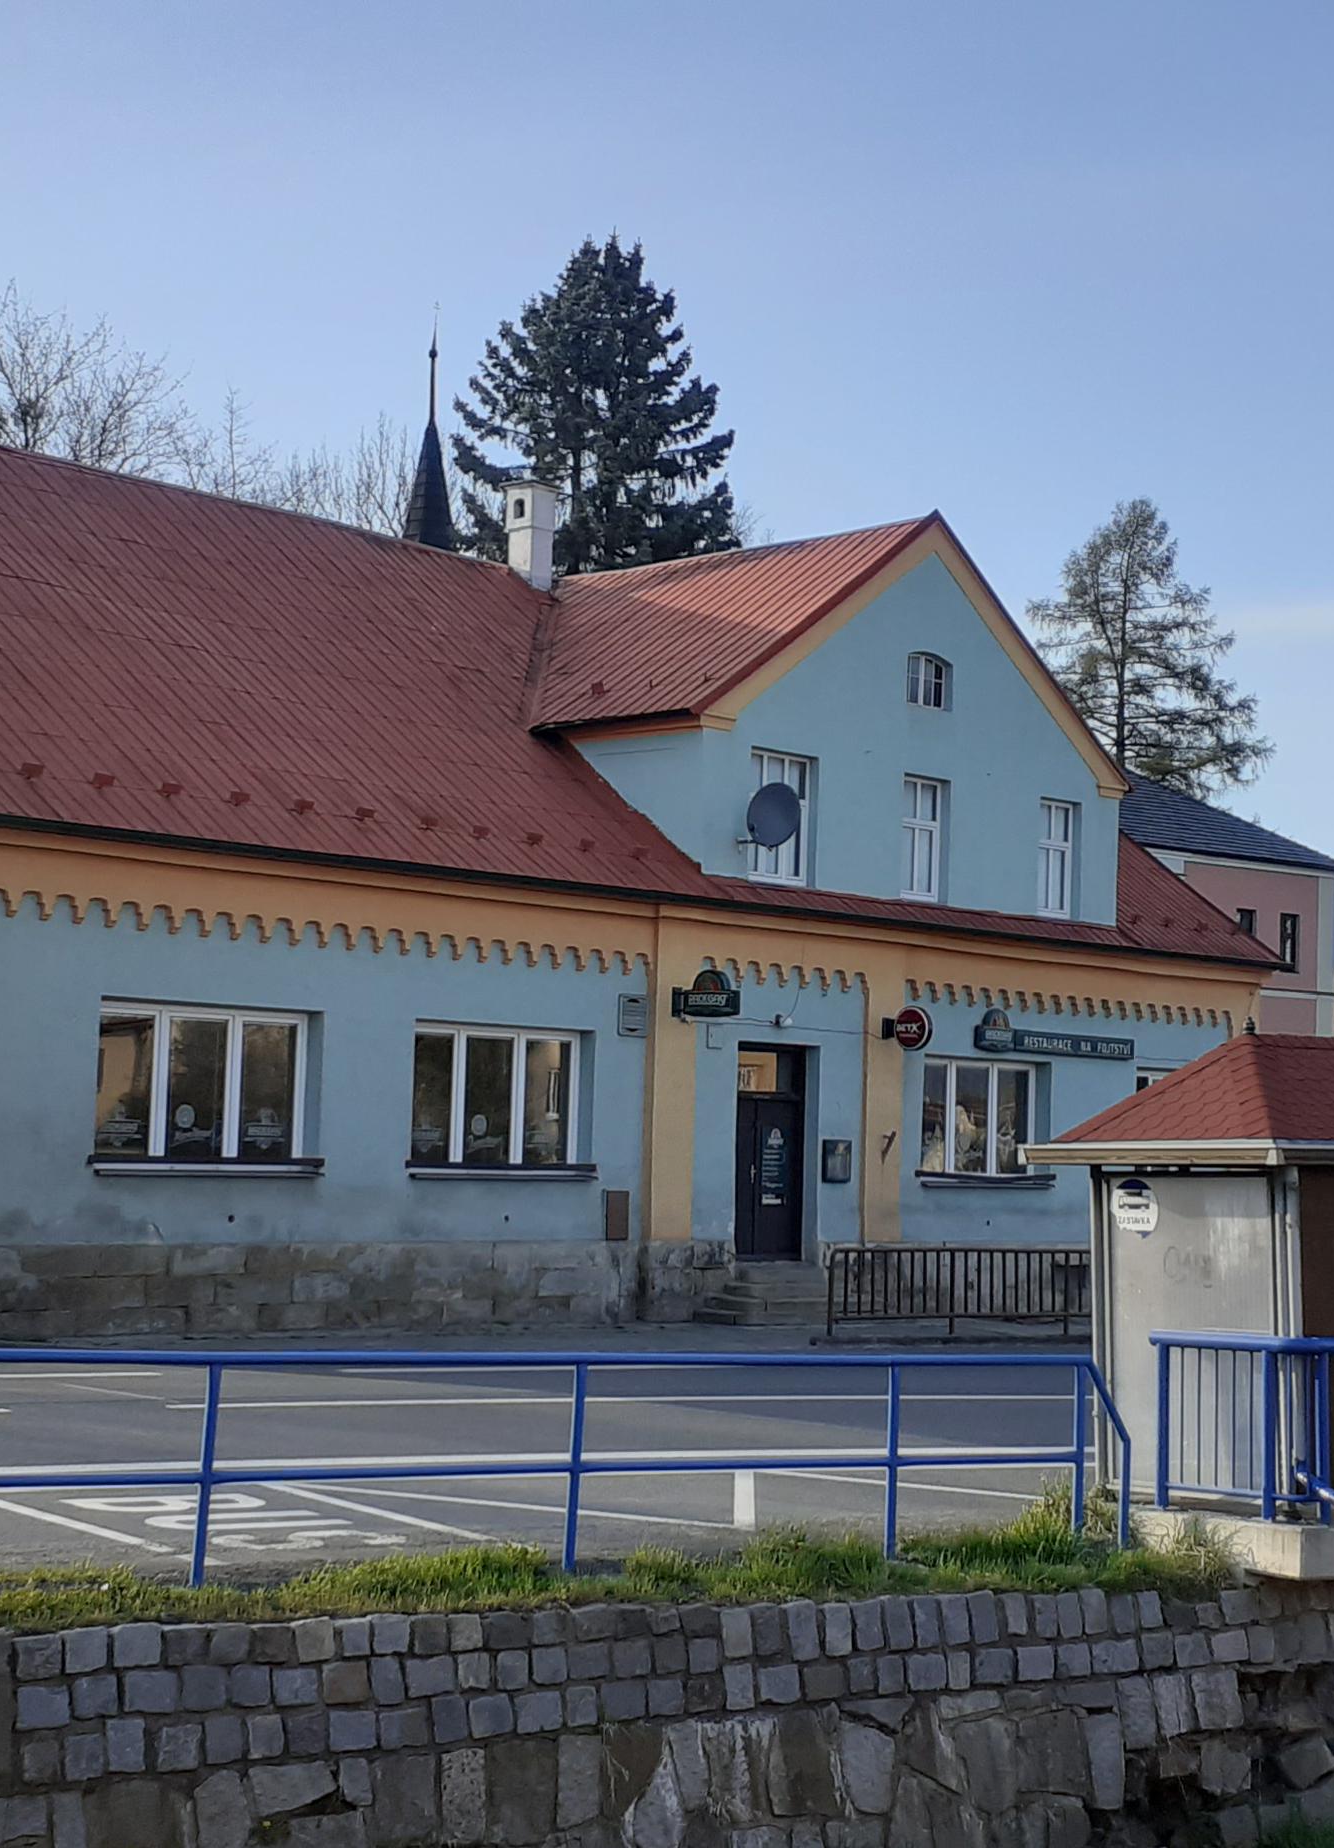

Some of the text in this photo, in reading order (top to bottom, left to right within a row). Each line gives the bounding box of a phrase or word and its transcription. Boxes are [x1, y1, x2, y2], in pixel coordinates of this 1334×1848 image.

[1023, 1035, 1072, 1050] RESTAURACE
[1080, 1041, 1091, 1052] NA
[59, 1493, 407, 1550] BUS
